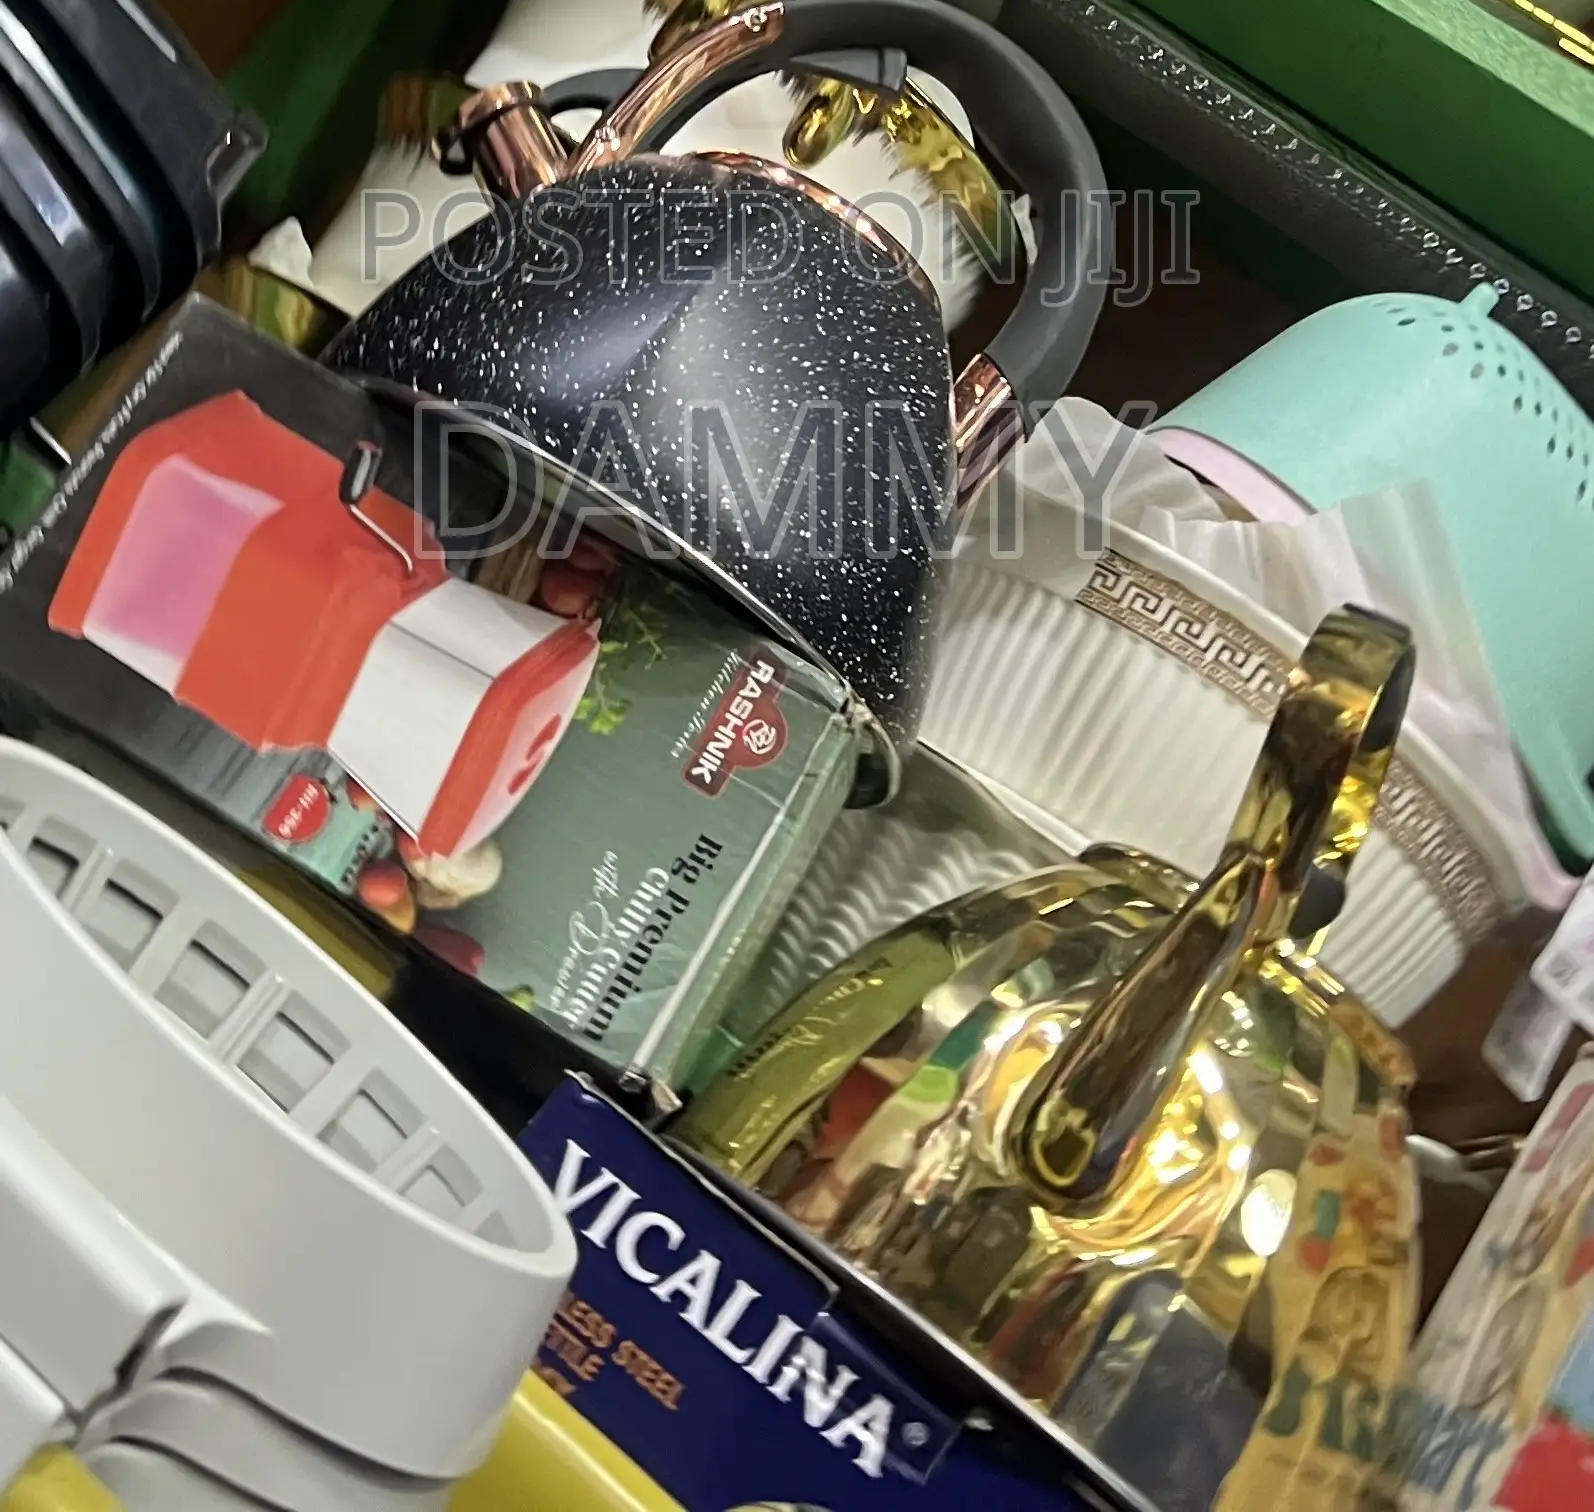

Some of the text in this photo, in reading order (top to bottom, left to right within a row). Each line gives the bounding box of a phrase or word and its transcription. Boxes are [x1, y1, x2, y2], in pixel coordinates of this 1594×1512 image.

[691, 659, 776, 784] RASHNIK
[562, 867, 670, 1029] Chilly Cutter
[582, 833, 723, 1042] Big Premium
[555, 1138, 894, 1479] VICALINA
[610, 1340, 685, 1411] STEEL
